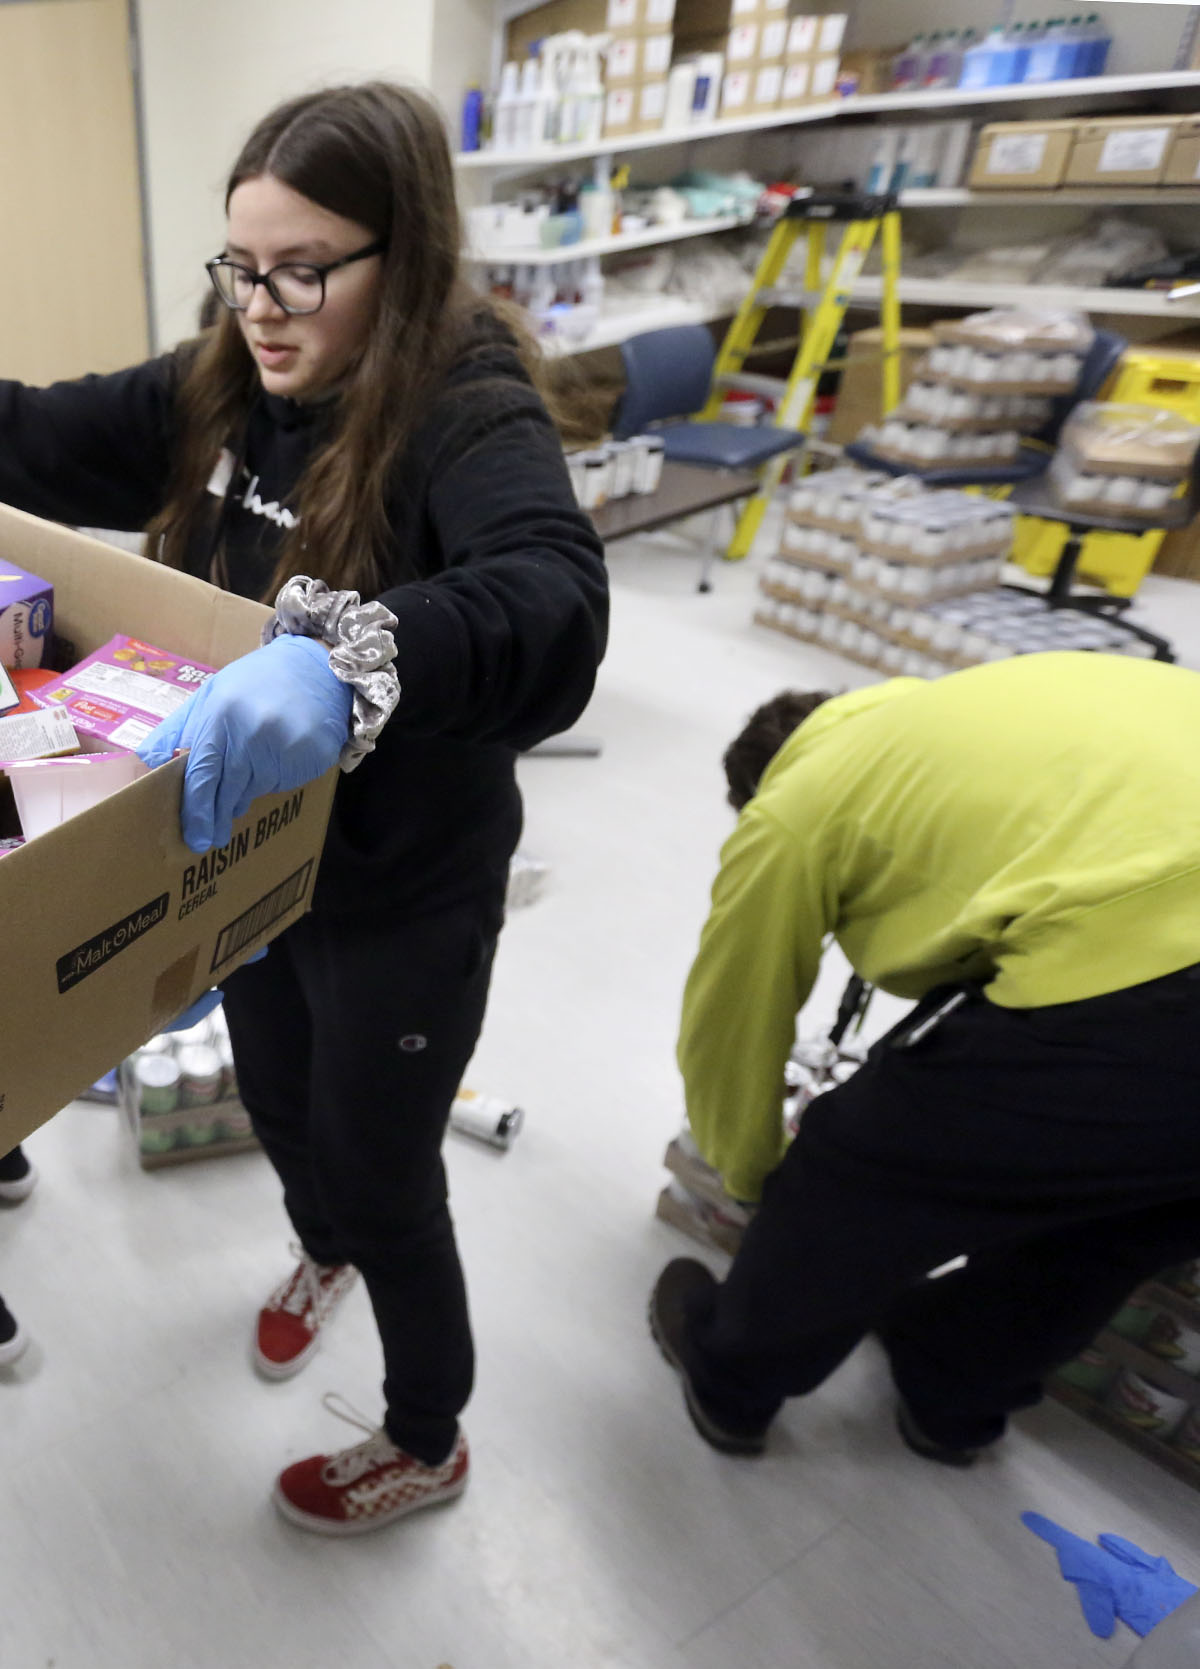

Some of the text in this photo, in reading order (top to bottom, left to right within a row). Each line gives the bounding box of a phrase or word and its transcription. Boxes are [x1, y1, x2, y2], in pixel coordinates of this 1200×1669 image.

[181, 789, 305, 900] RAISIN BRAN
[178, 881, 218, 921] CEREAL
